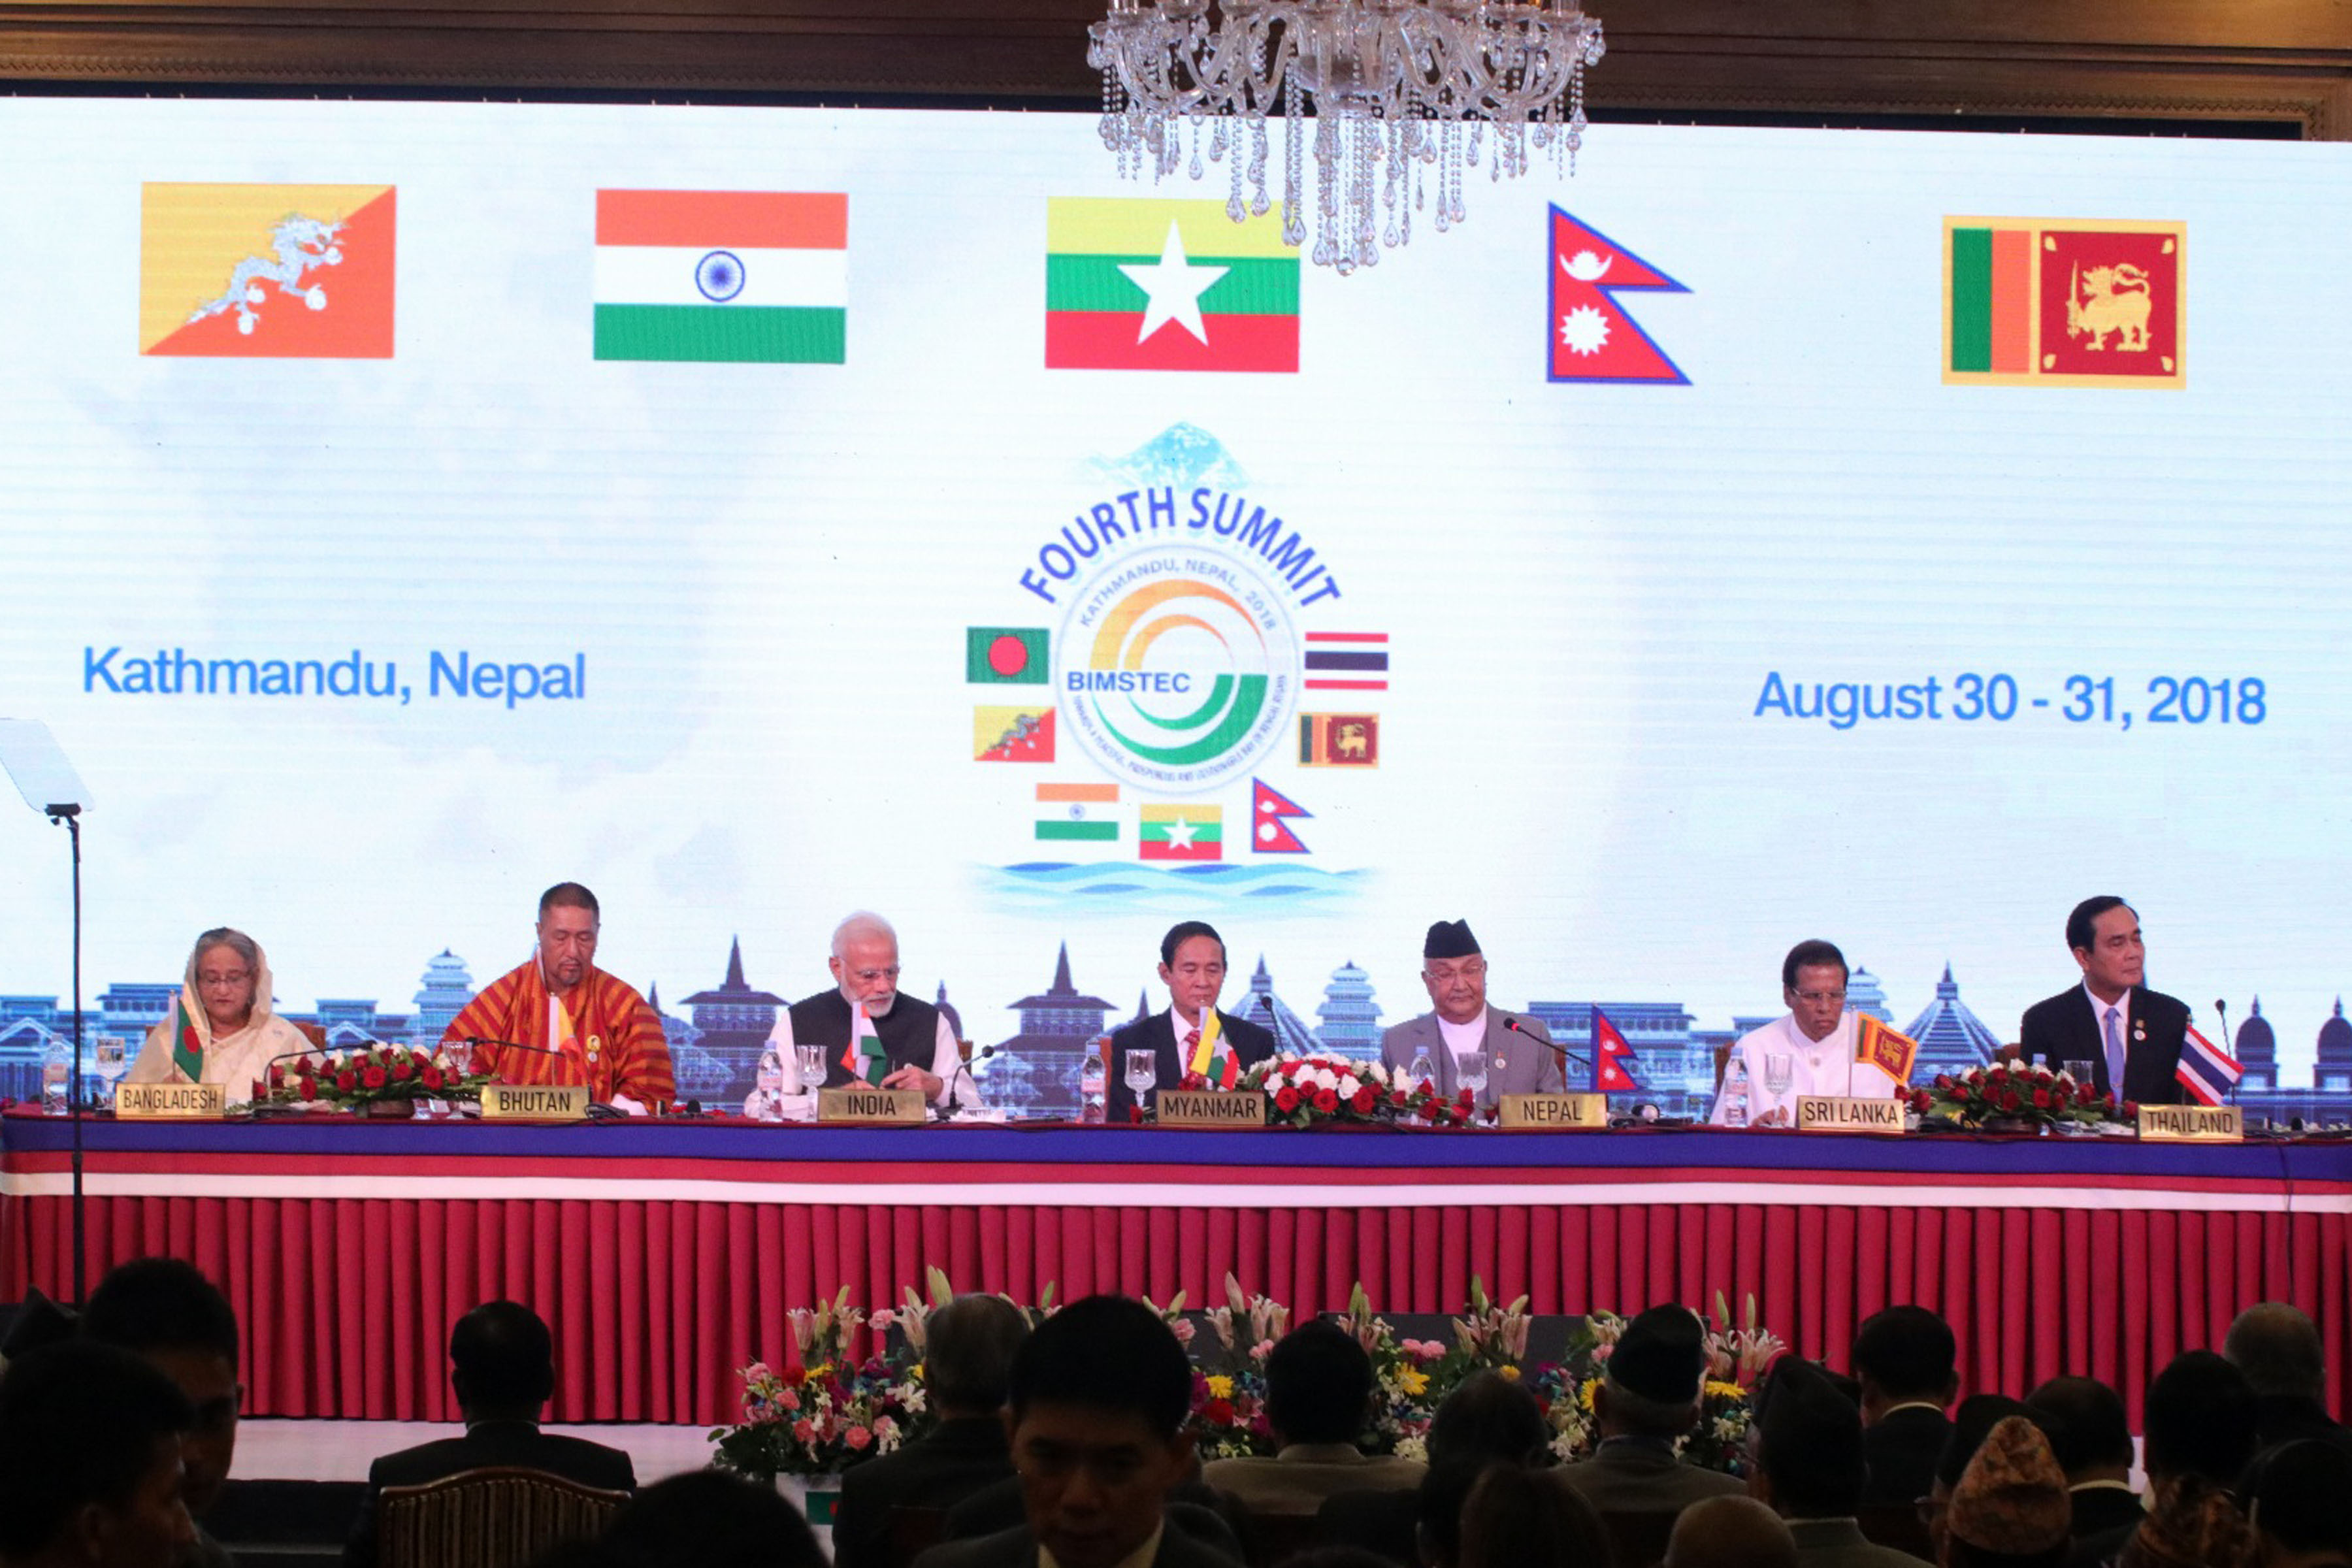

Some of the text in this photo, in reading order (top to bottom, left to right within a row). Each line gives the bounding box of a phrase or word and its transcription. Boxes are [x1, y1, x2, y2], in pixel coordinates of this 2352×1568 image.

[1019, 486, 1341, 606] FOURTH SUMMIT
[1245, 590, 1276, 630] 2018
[83, 645, 586, 710] Kathmandu, Nepal
[1067, 671, 1191, 693] BIMSTEC
[1754, 671, 2267, 732] August 30 - 31, 2018
[123, 1089, 218, 1109] BANGLADESH
[499, 1091, 570, 1111] BHUTAN
[847, 1095, 896, 1115] INDIA
[1164, 1096, 1257, 1118] MYANMAR
[1524, 1100, 1582, 1121] NEPAL
[1805, 1102, 1898, 1124] SRI LANKA
[2148, 1112, 2233, 1133] THAILAND
